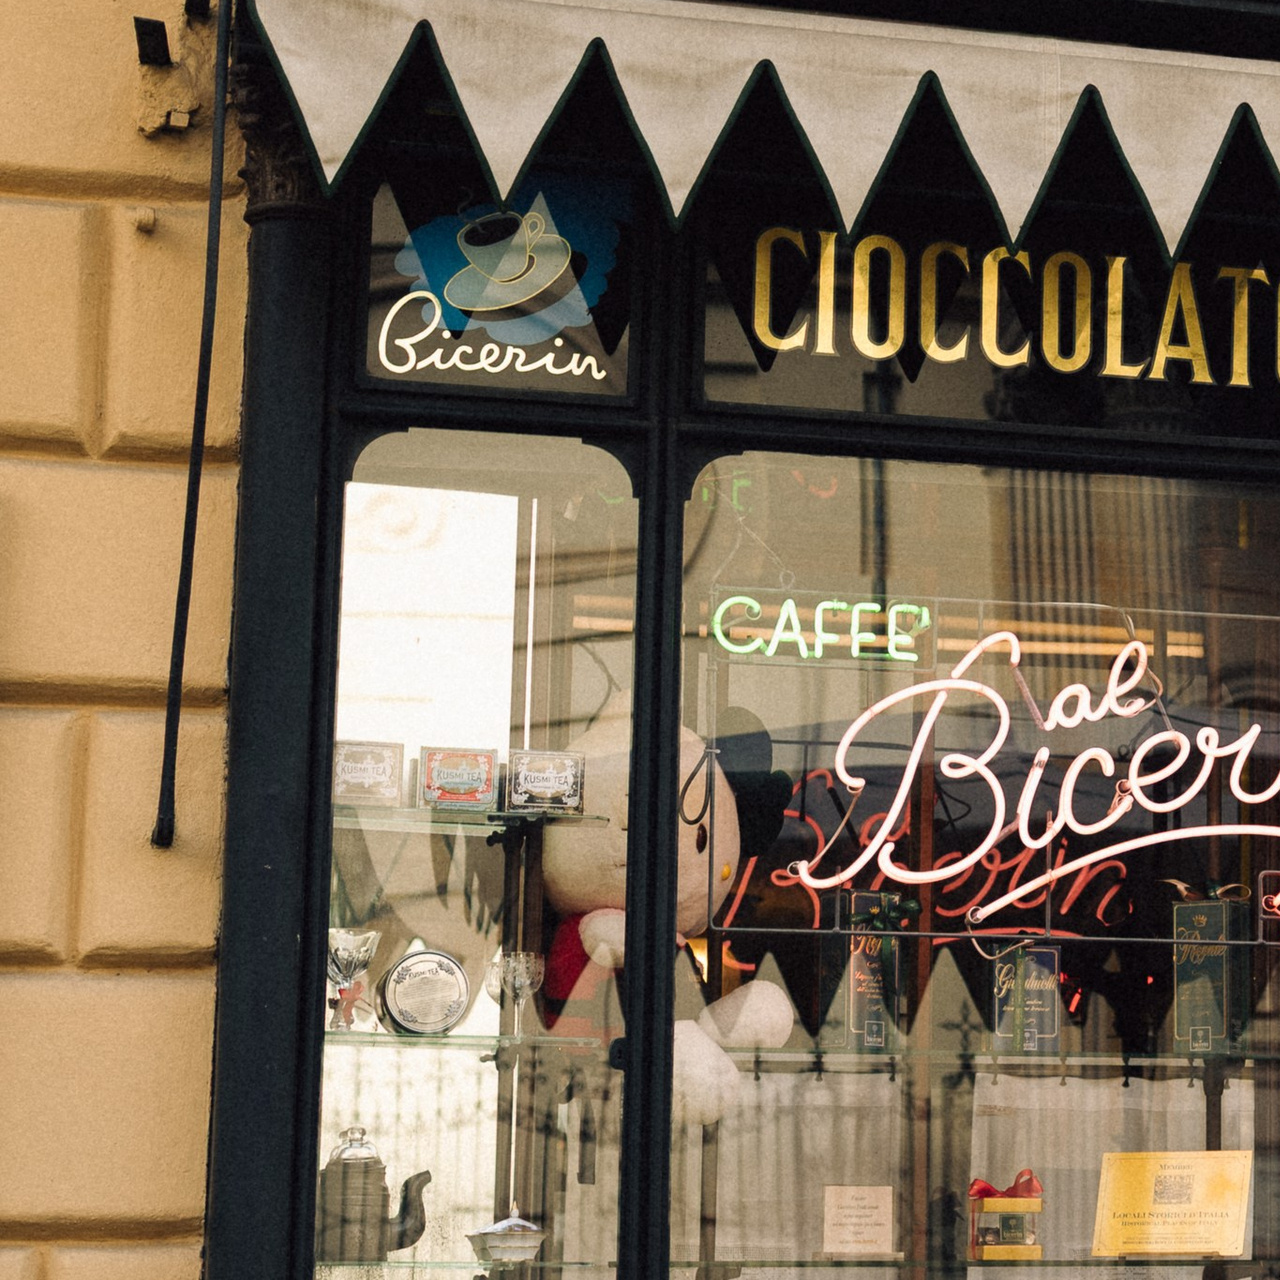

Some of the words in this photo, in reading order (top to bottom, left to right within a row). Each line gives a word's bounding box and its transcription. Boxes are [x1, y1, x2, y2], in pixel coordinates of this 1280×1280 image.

[378, 290, 606, 380] Bicerin
[1042, 639, 1152, 732] al
[340, 765, 369, 775] KUSMI
[371, 766, 387, 777] TEA
[437, 769, 464, 781] KUSMI
[467, 771, 482, 782] TEA
[523, 773, 551, 784] KUSMI
[554, 775, 569, 786] TEA
